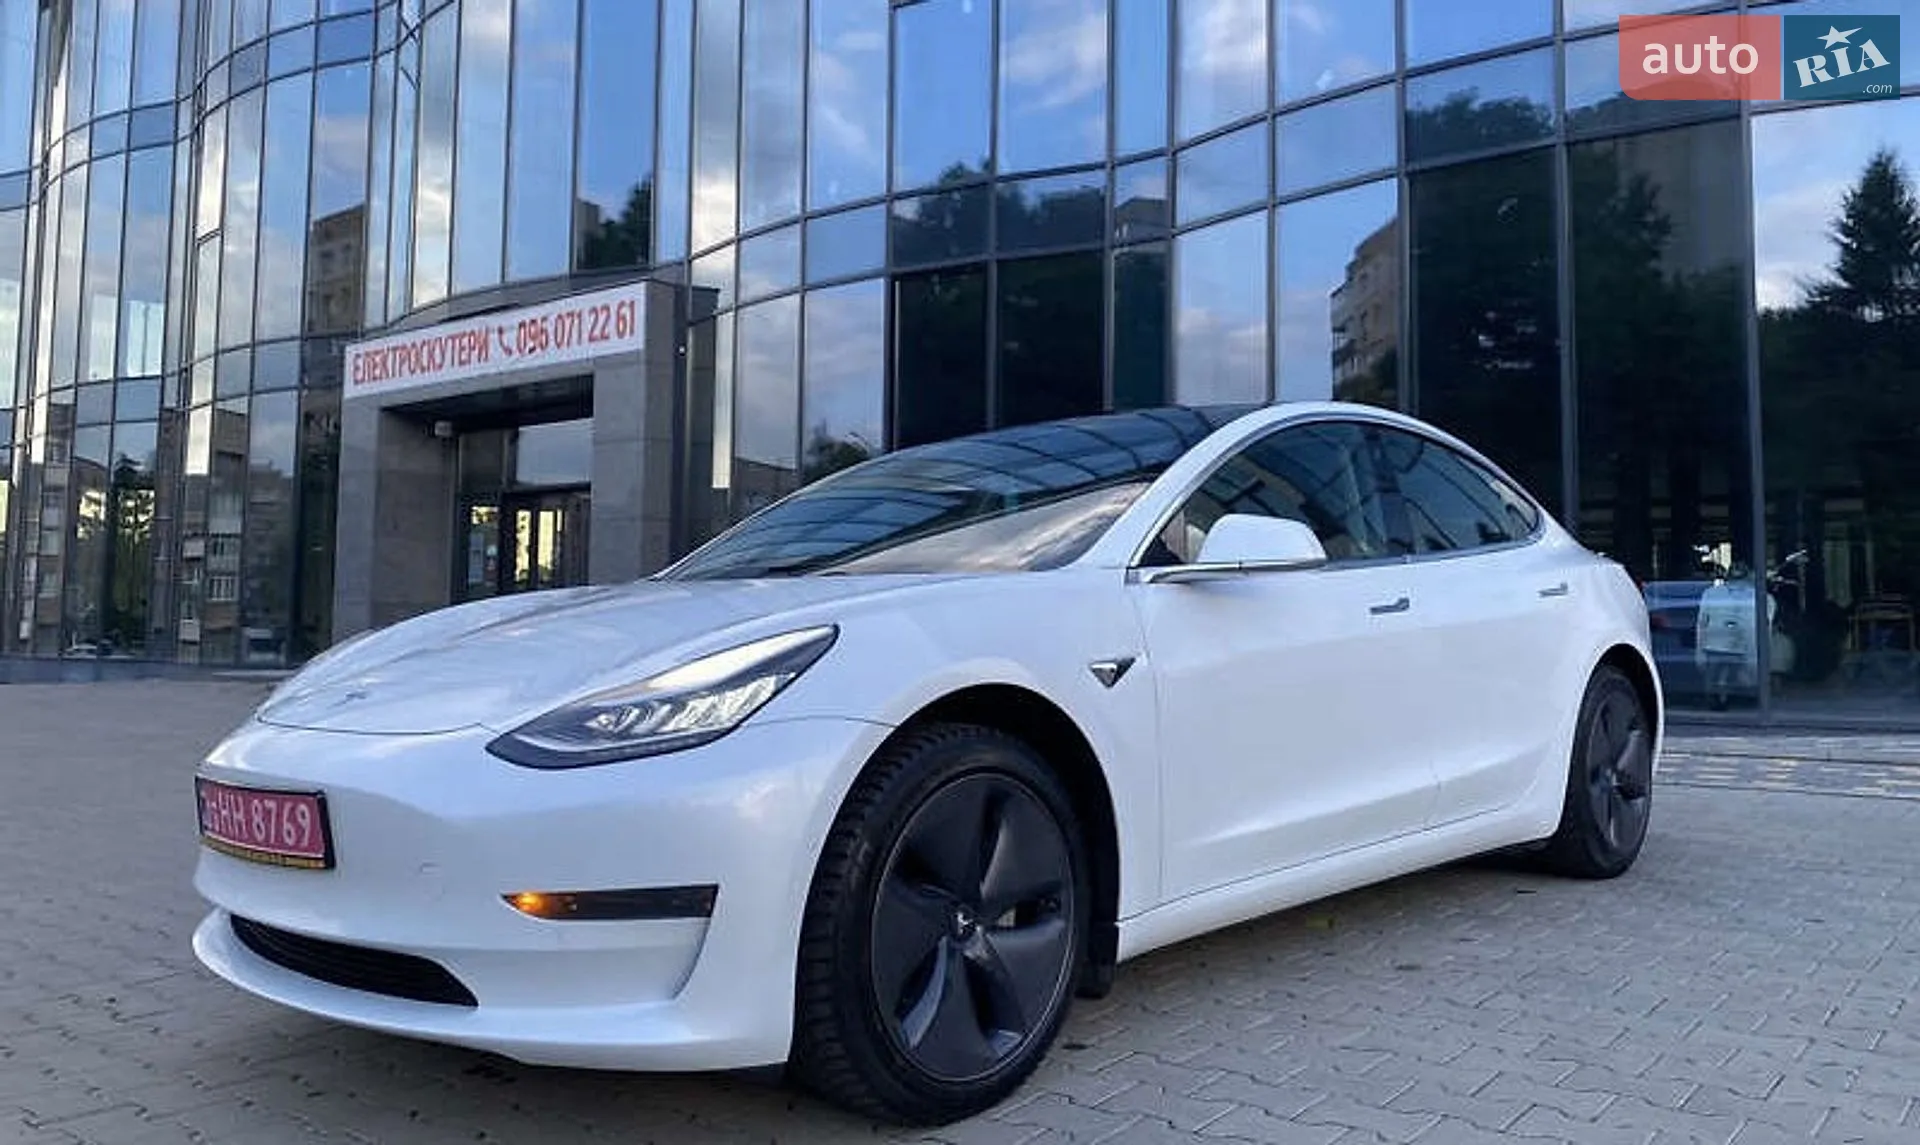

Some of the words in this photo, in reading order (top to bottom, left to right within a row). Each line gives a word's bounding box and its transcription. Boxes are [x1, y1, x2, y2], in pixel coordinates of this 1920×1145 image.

[352, 325, 489, 386] ЕЛЕКТРОСКУТЕРИ
[516, 316, 549, 354] 096
[554, 310, 583, 350] 071
[588, 303, 611, 342] 22
[616, 300, 636, 339] 61
[252, 799, 311, 847] 8769
